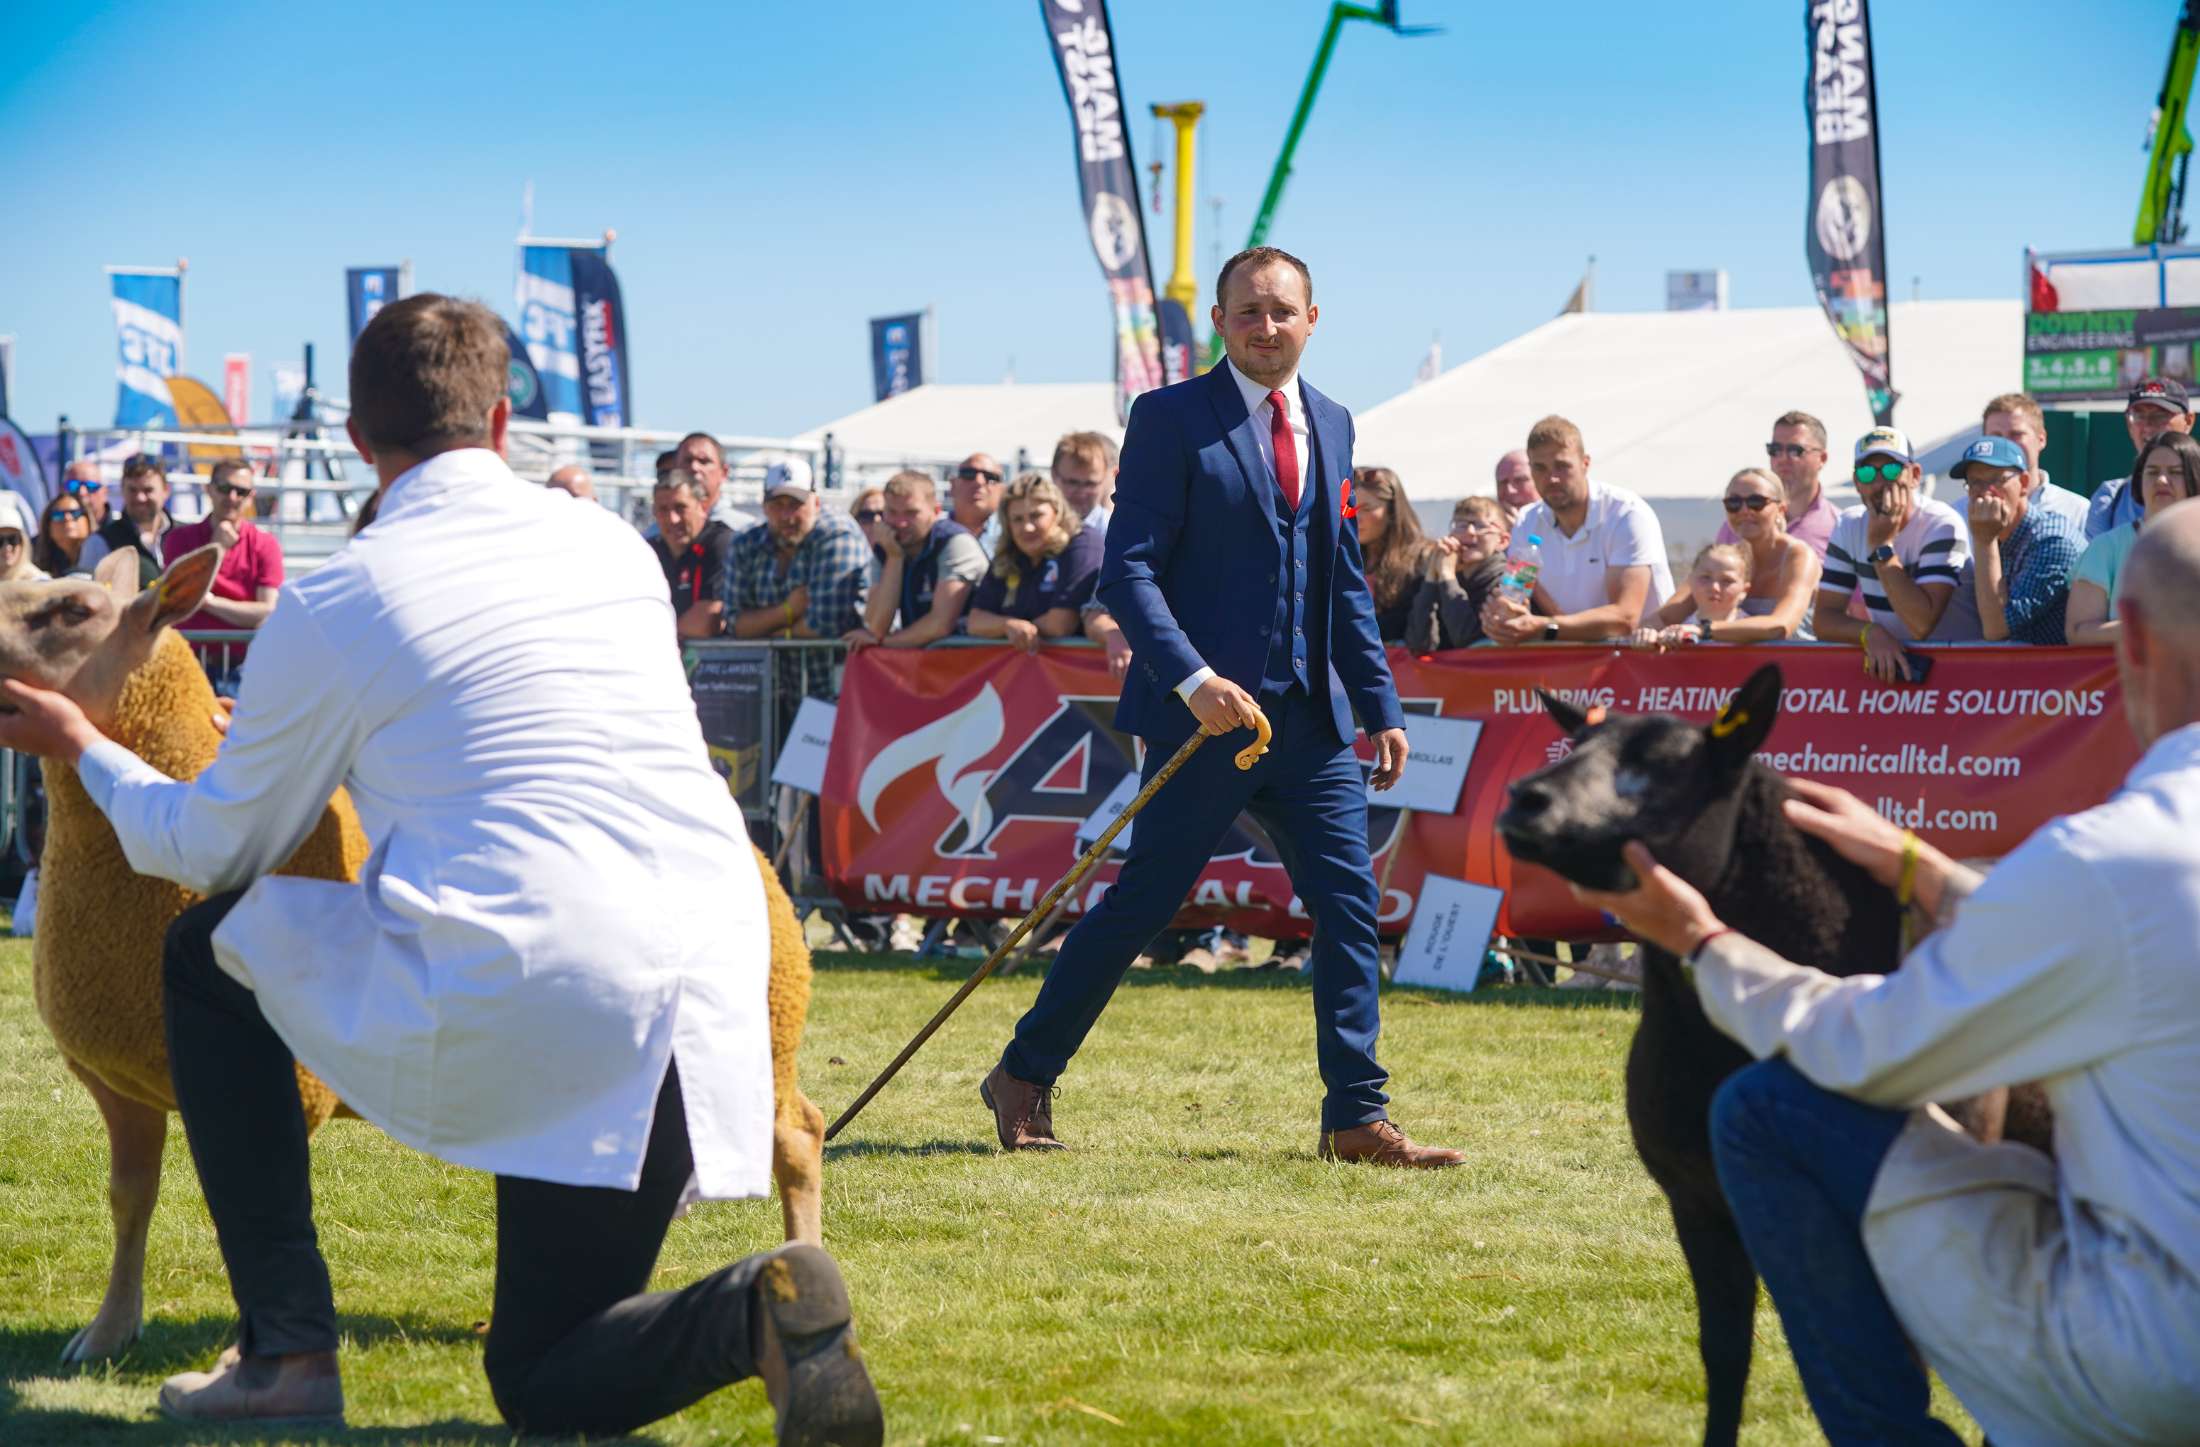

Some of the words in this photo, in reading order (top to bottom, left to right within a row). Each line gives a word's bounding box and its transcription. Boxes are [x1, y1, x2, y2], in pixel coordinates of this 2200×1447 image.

[2028, 331, 2135, 349] ENGINEERING
[1858, 689, 1939, 714] HOME
[1944, 689, 2105, 717] SOLUTIONS
[1752, 742, 2021, 778] mechanicalltd.com
[1433, 955, 1445, 971] DE
